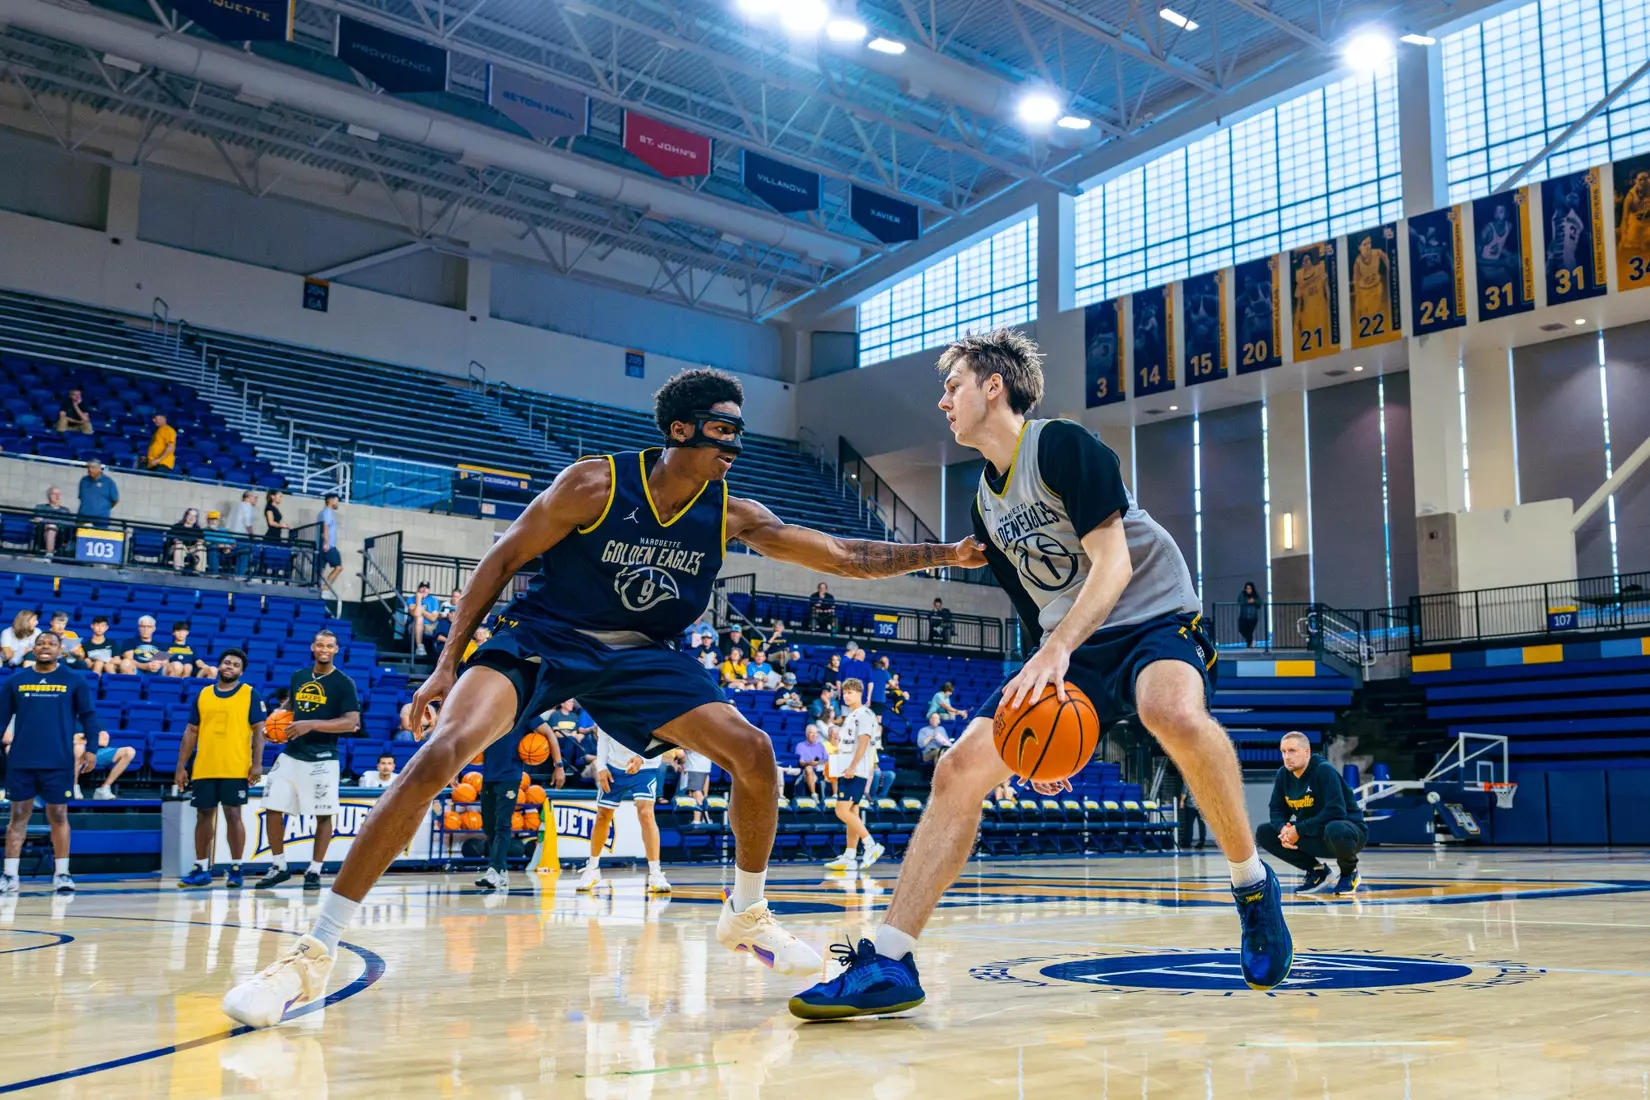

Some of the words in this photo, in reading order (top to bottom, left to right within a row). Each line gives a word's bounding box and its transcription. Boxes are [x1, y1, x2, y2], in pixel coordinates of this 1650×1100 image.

[209, 0, 271, 22] QUETTE
[352, 42, 433, 73] PROVIDENCE
[757, 173, 808, 195] VILLANOVA
[870, 208, 901, 224] XAVIER
[1555, 266, 1585, 294] 31
[1485, 282, 1513, 310] 31
[1420, 298, 1449, 325] 24
[1359, 313, 1384, 338] 22
[1300, 328, 1322, 351] 21
[1190, 352, 1213, 376] 15
[1243, 341, 1267, 365] 20
[1097, 377, 1107, 398] 3
[1140, 364, 1160, 388] 14
[85, 541, 114, 558] 103
[640, 537, 681, 548] MARQUETTE
[601, 540, 656, 565] GOLDEN
[656, 548, 705, 576] EAGLES
[637, 580, 656, 604] 9
[879, 623, 894, 635] 105
[1554, 614, 1571, 627] 107
